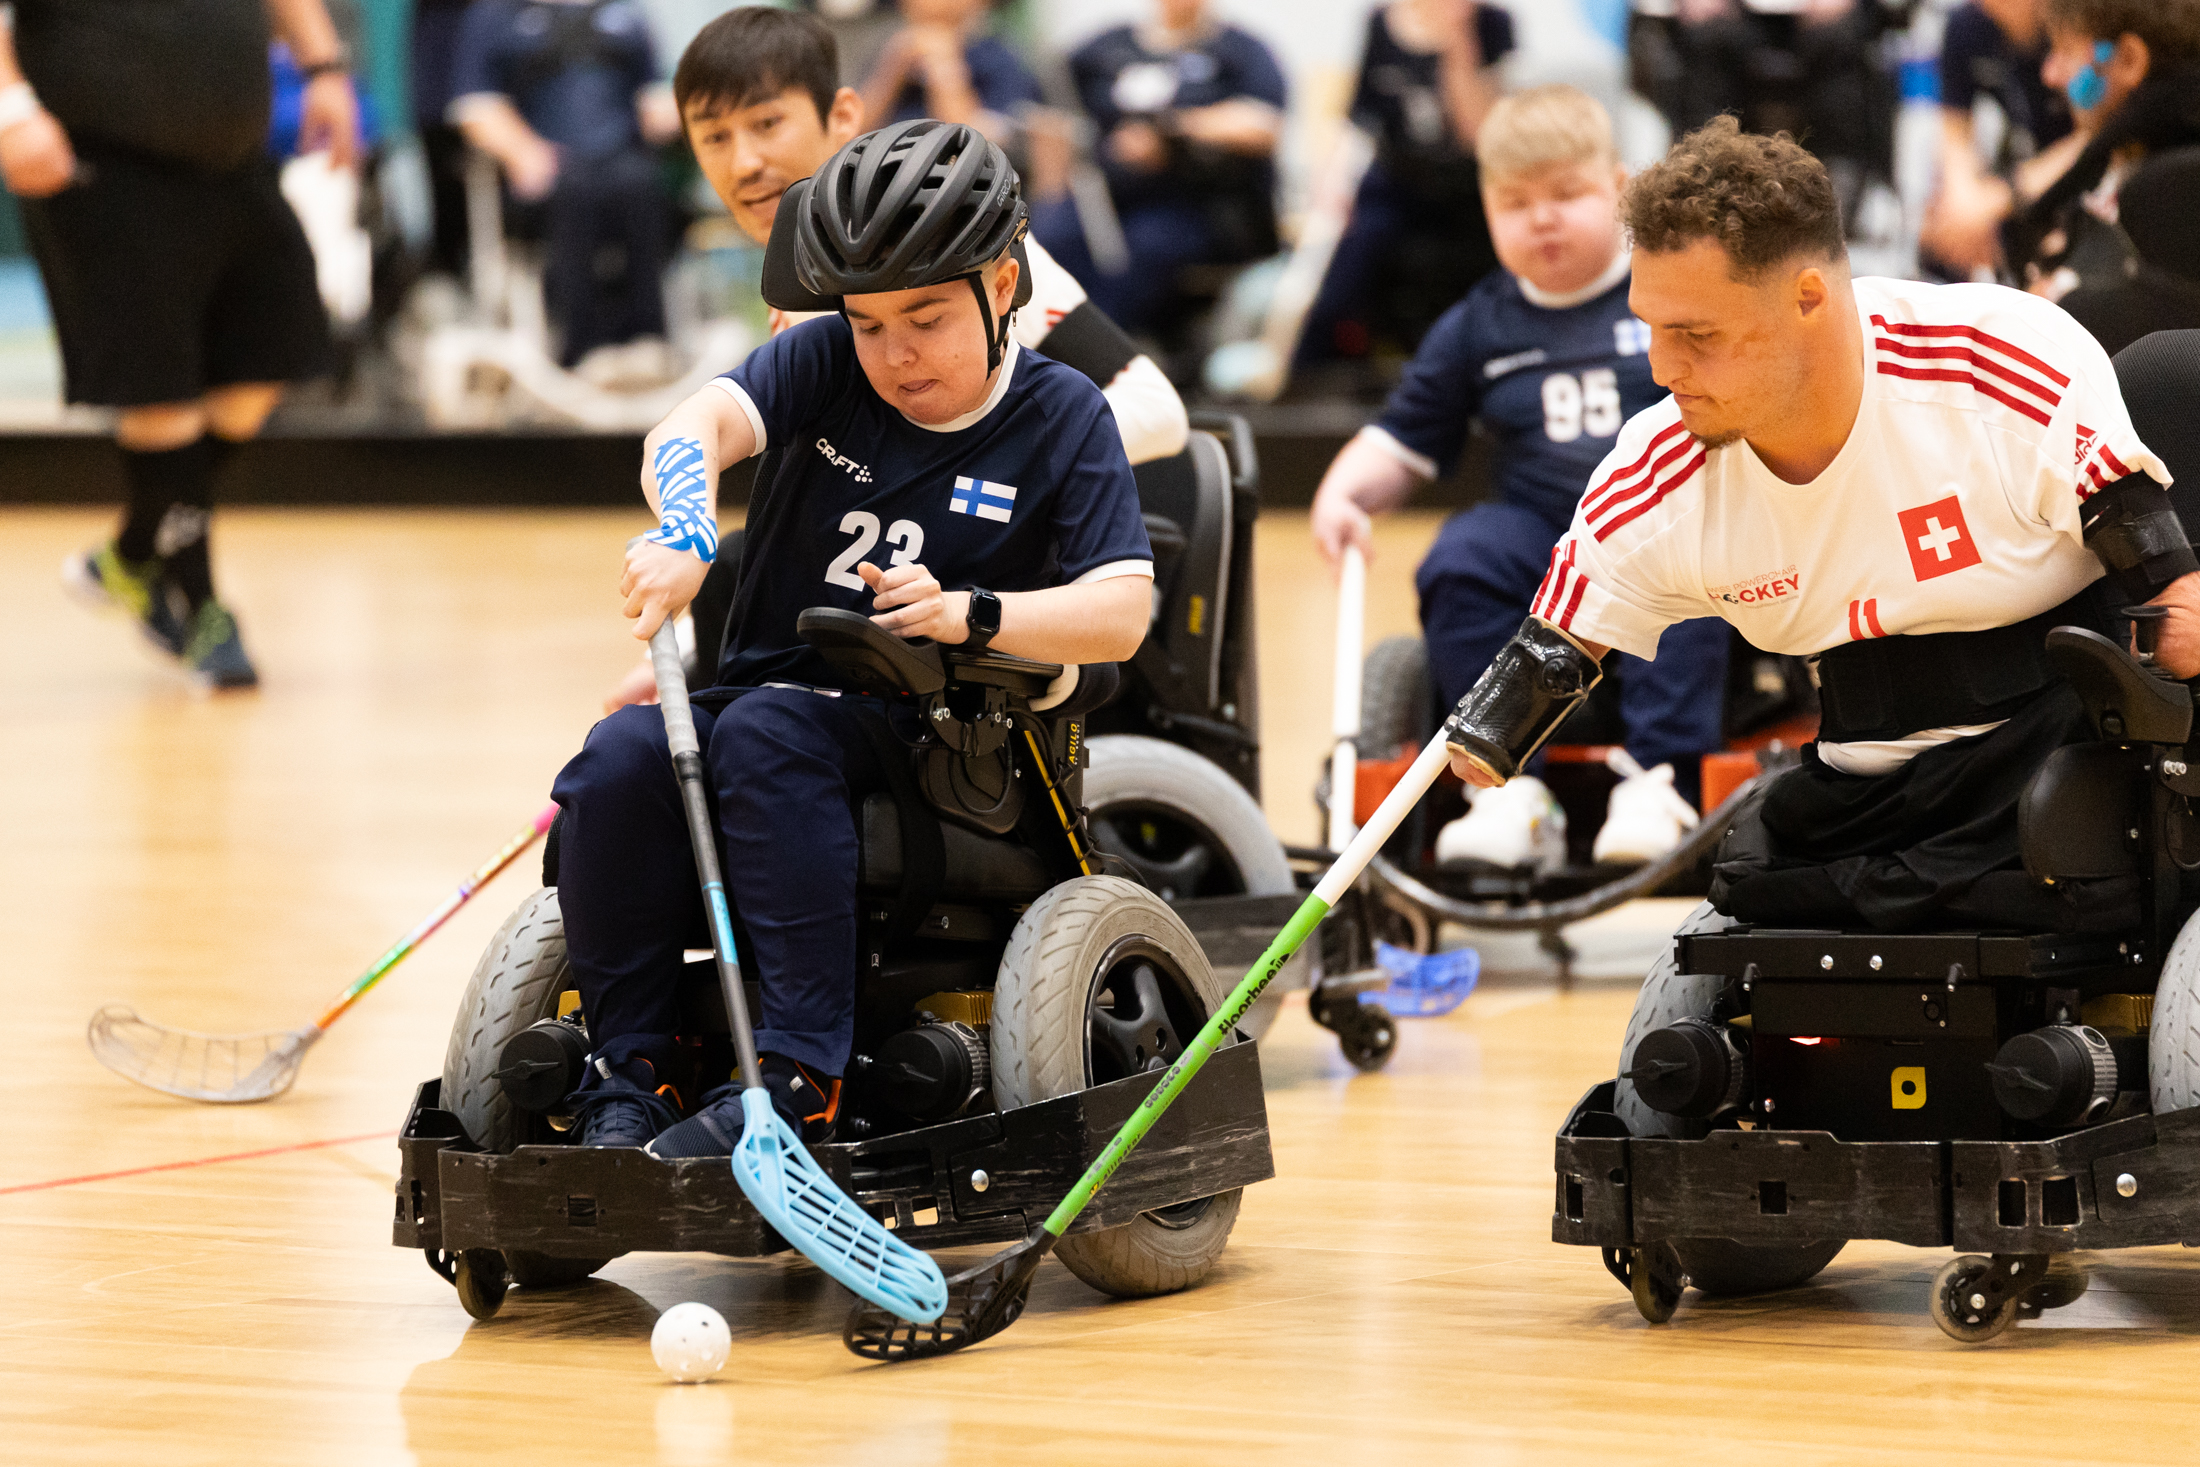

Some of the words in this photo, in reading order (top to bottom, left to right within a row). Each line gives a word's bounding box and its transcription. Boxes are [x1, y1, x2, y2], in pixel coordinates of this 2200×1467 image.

[997, 179, 1011, 207] GIRO
[1541, 367, 1622, 443] 95
[824, 511, 924, 592] 23
[1848, 598, 1889, 641] 11
[1069, 723, 1078, 764] AGILO
